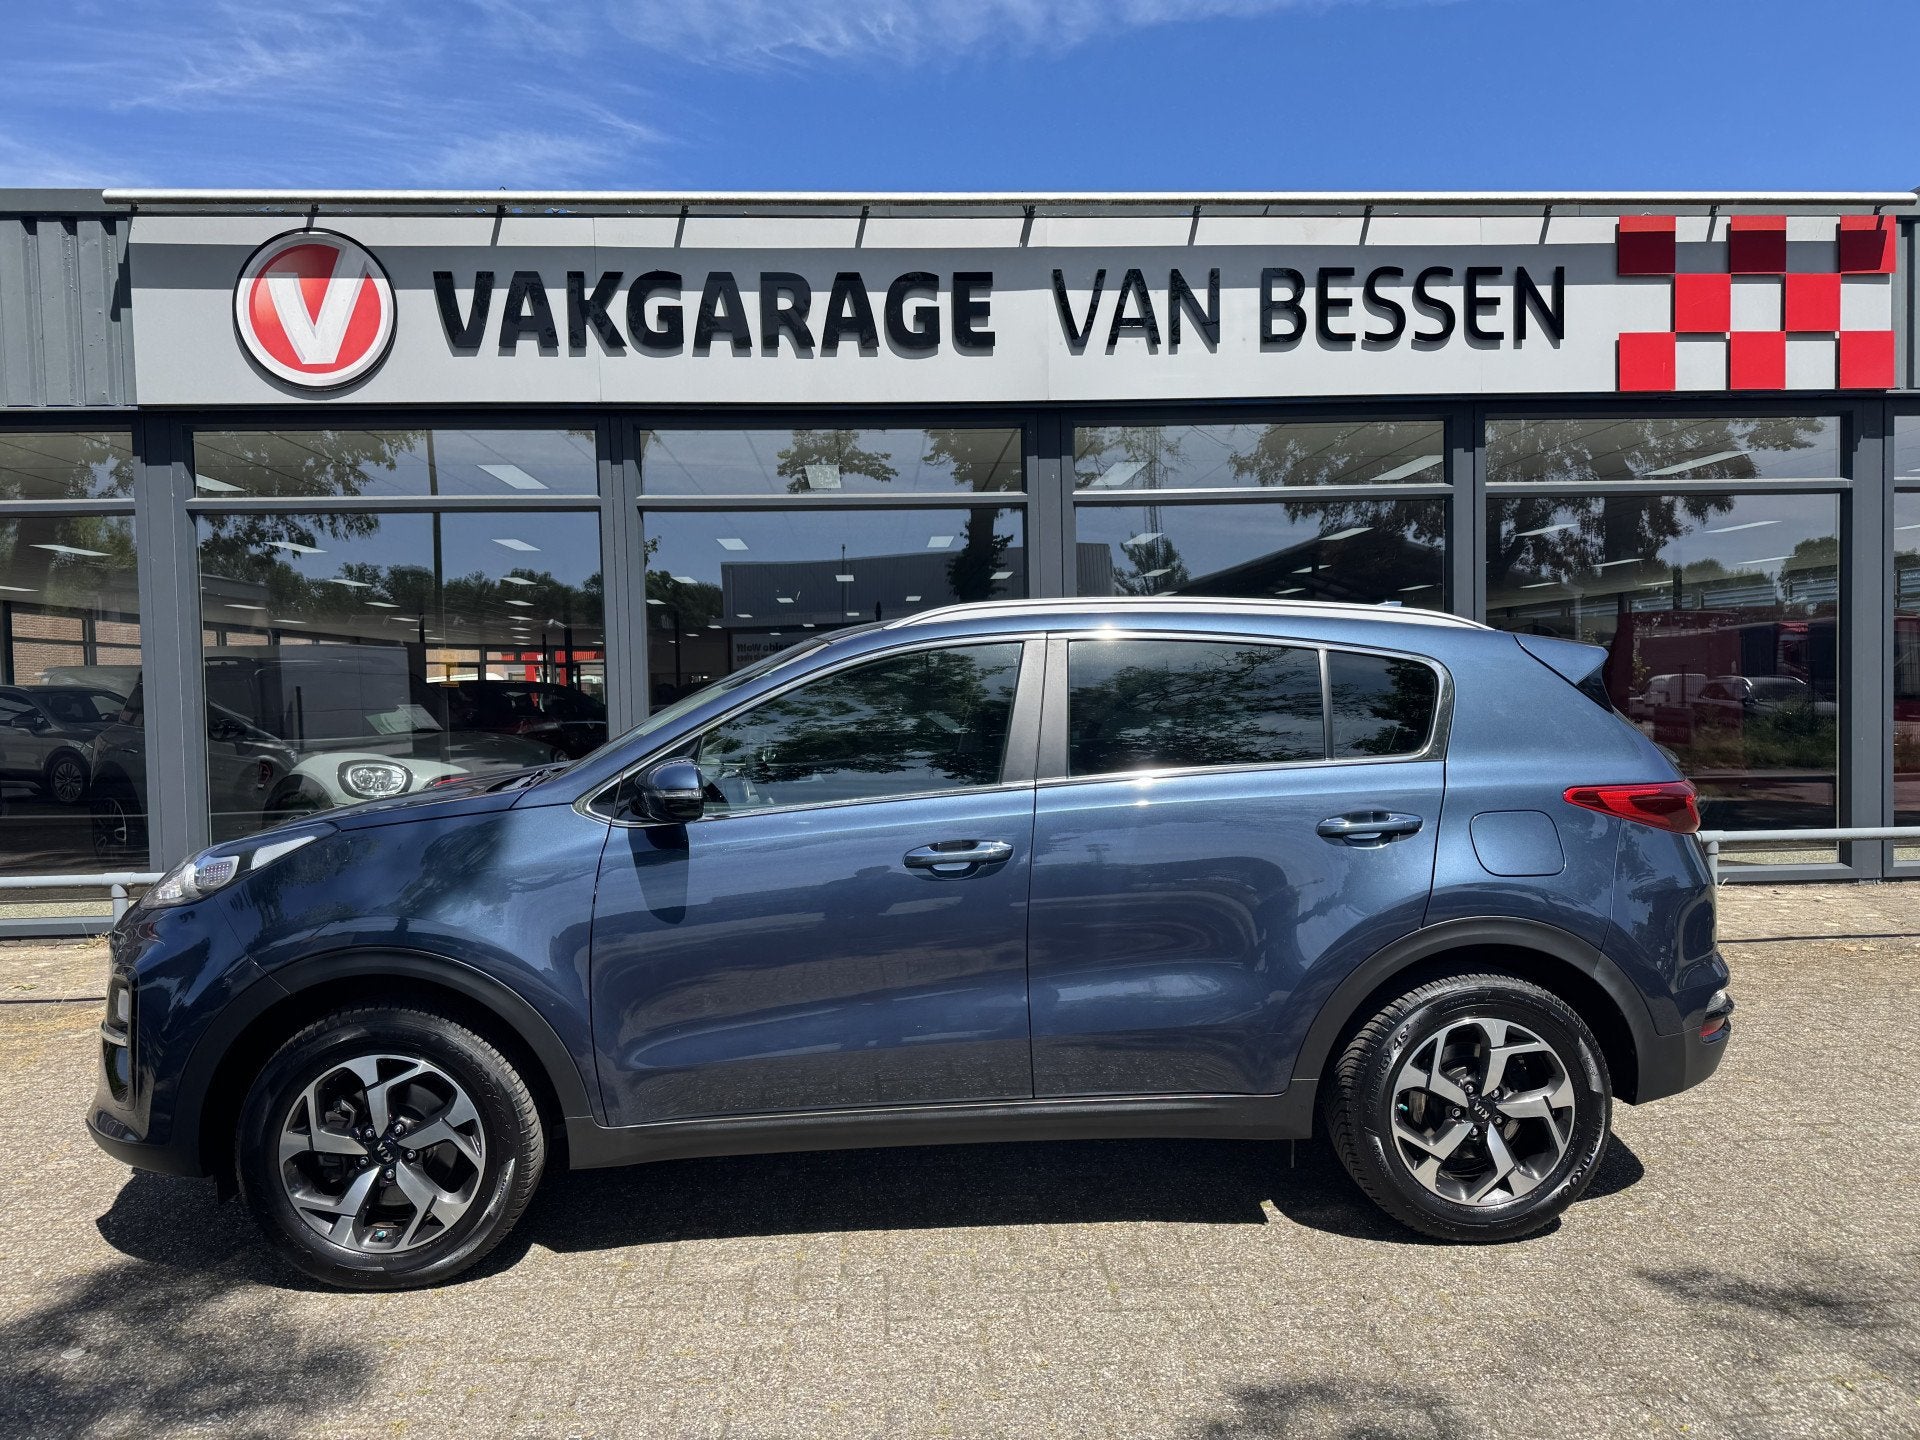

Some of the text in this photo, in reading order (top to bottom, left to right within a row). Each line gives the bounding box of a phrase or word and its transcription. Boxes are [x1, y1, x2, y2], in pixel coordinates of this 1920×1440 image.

[433, 266, 1565, 349] VAKGARAGE VAN BESSEN
[1474, 1102, 1490, 1120] KIA
[376, 1142, 394, 1162] KIA
